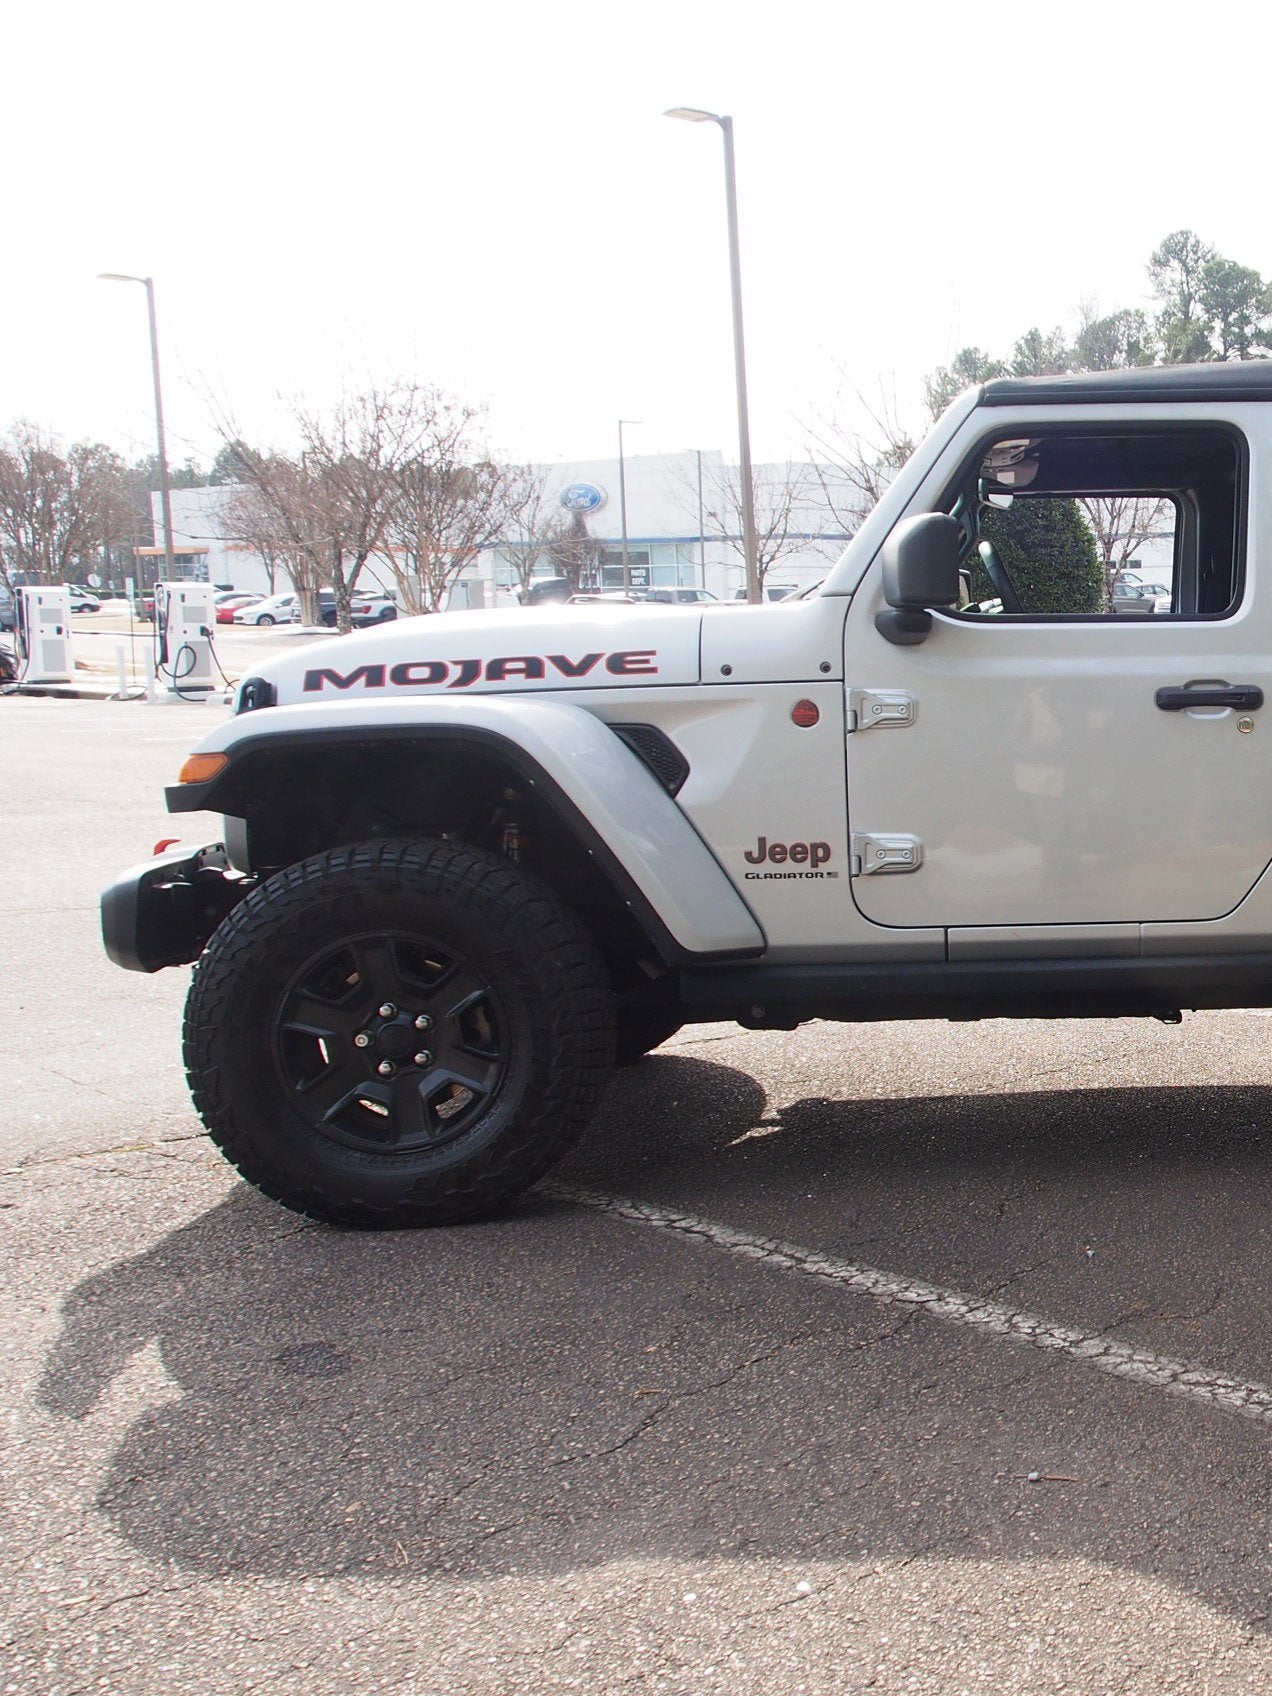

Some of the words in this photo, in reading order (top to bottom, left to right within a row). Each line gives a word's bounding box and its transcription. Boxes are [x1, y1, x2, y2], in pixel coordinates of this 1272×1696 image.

[567, 488, 592, 507] Ford
[630, 569, 647, 577] PARTS
[302, 650, 659, 693] MOJAVE
[743, 836, 831, 868] Jeep
[744, 871, 824, 879] GLADIATOR
